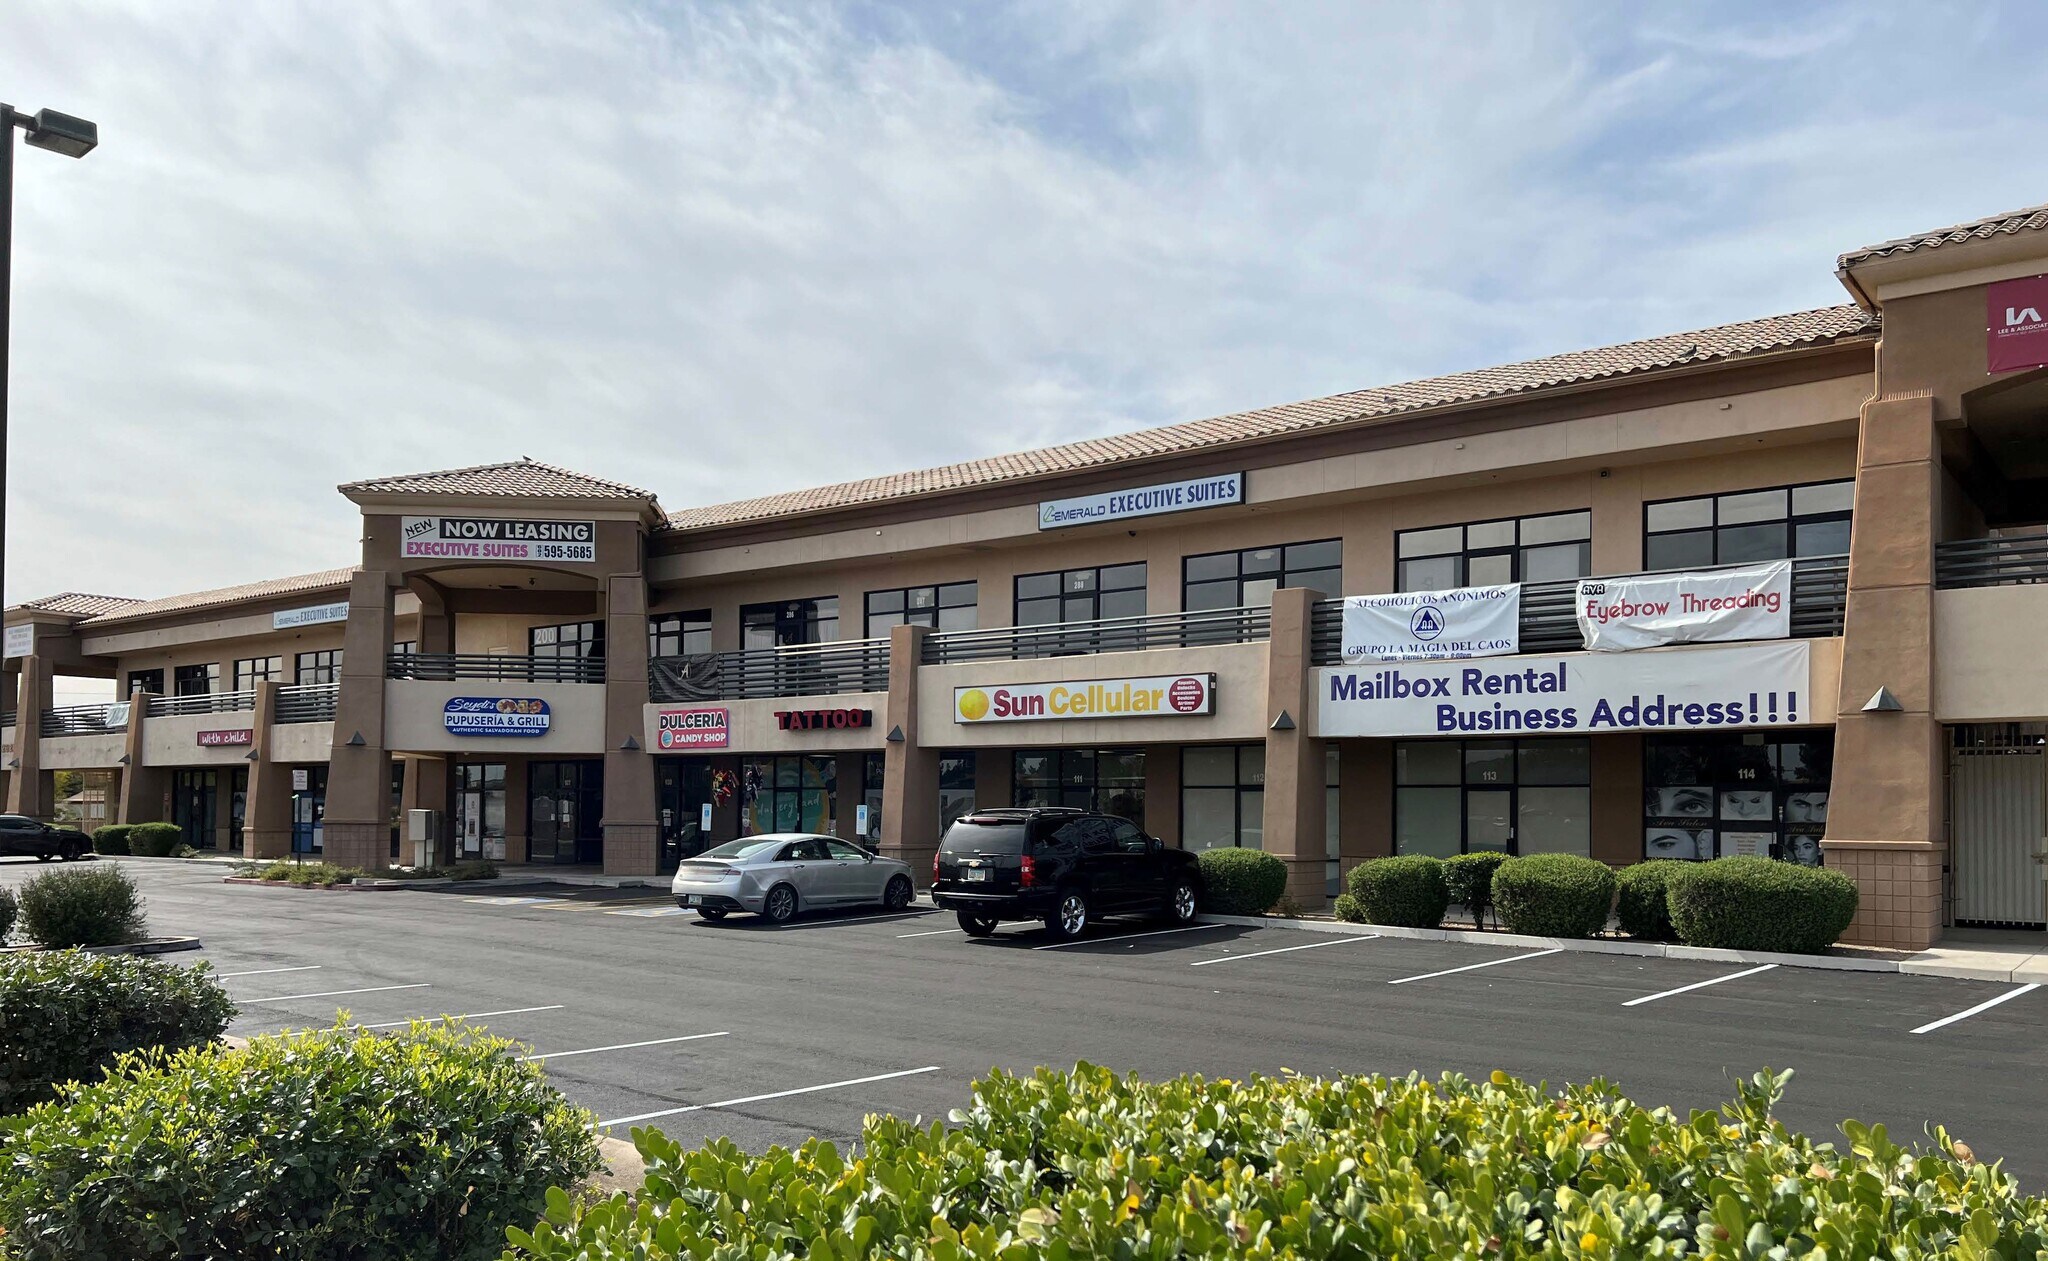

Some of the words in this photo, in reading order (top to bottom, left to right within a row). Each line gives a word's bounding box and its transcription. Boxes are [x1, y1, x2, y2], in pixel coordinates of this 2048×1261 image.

[1052, 505, 1106, 522] EMERALD
[1109, 487, 1183, 514] EXECUTIVE
[1187, 479, 1236, 503] SUITES
[405, 518, 433, 537] NEW
[445, 521, 500, 538] NOW
[504, 522, 589, 540] LEASING
[406, 542, 479, 557] EXECUTIVE
[482, 543, 529, 558] SUITES
[544, 545, 592, 559] 595-5685
[1581, 584, 1605, 595] AVA
[300, 608, 328, 622] EXECUTIVE
[329, 605, 348, 618] SUITES
[1586, 598, 1670, 624] Eyebrow
[1680, 588, 1781, 613] Threading
[1420, 619, 1434, 630] AA
[535, 628, 556, 644] 200
[1347, 644, 1387, 656] GRUPO
[1389, 643, 1405, 654] LA
[1408, 642, 1448, 653] MAGIA
[1451, 641, 1475, 651] DEL
[1478, 639, 1511, 650] CAOS
[1330, 670, 1451, 701] Mailbox
[1462, 662, 1567, 696] Rental
[993, 689, 1044, 717] Sun
[1049, 683, 1164, 715] Cellular
[1436, 702, 1578, 731] Business
[1588, 691, 1797, 727] Address!!!
[446, 714, 505, 726] PUPUSERÍA
[507, 716, 515, 726] &
[517, 717, 547, 726] GRILL
[659, 713, 725, 730] DULCERIA
[774, 709, 864, 730] TATTOO
[201, 732, 221, 743] with
[224, 731, 247, 743] child
[675, 733, 703, 743] CANDY
[703, 733, 726, 742] SHOP
[1073, 775, 1083, 783] 111
[1252, 774, 1265, 782] 112
[1482, 771, 1497, 781] 113
[1737, 768, 1756, 779] 114
